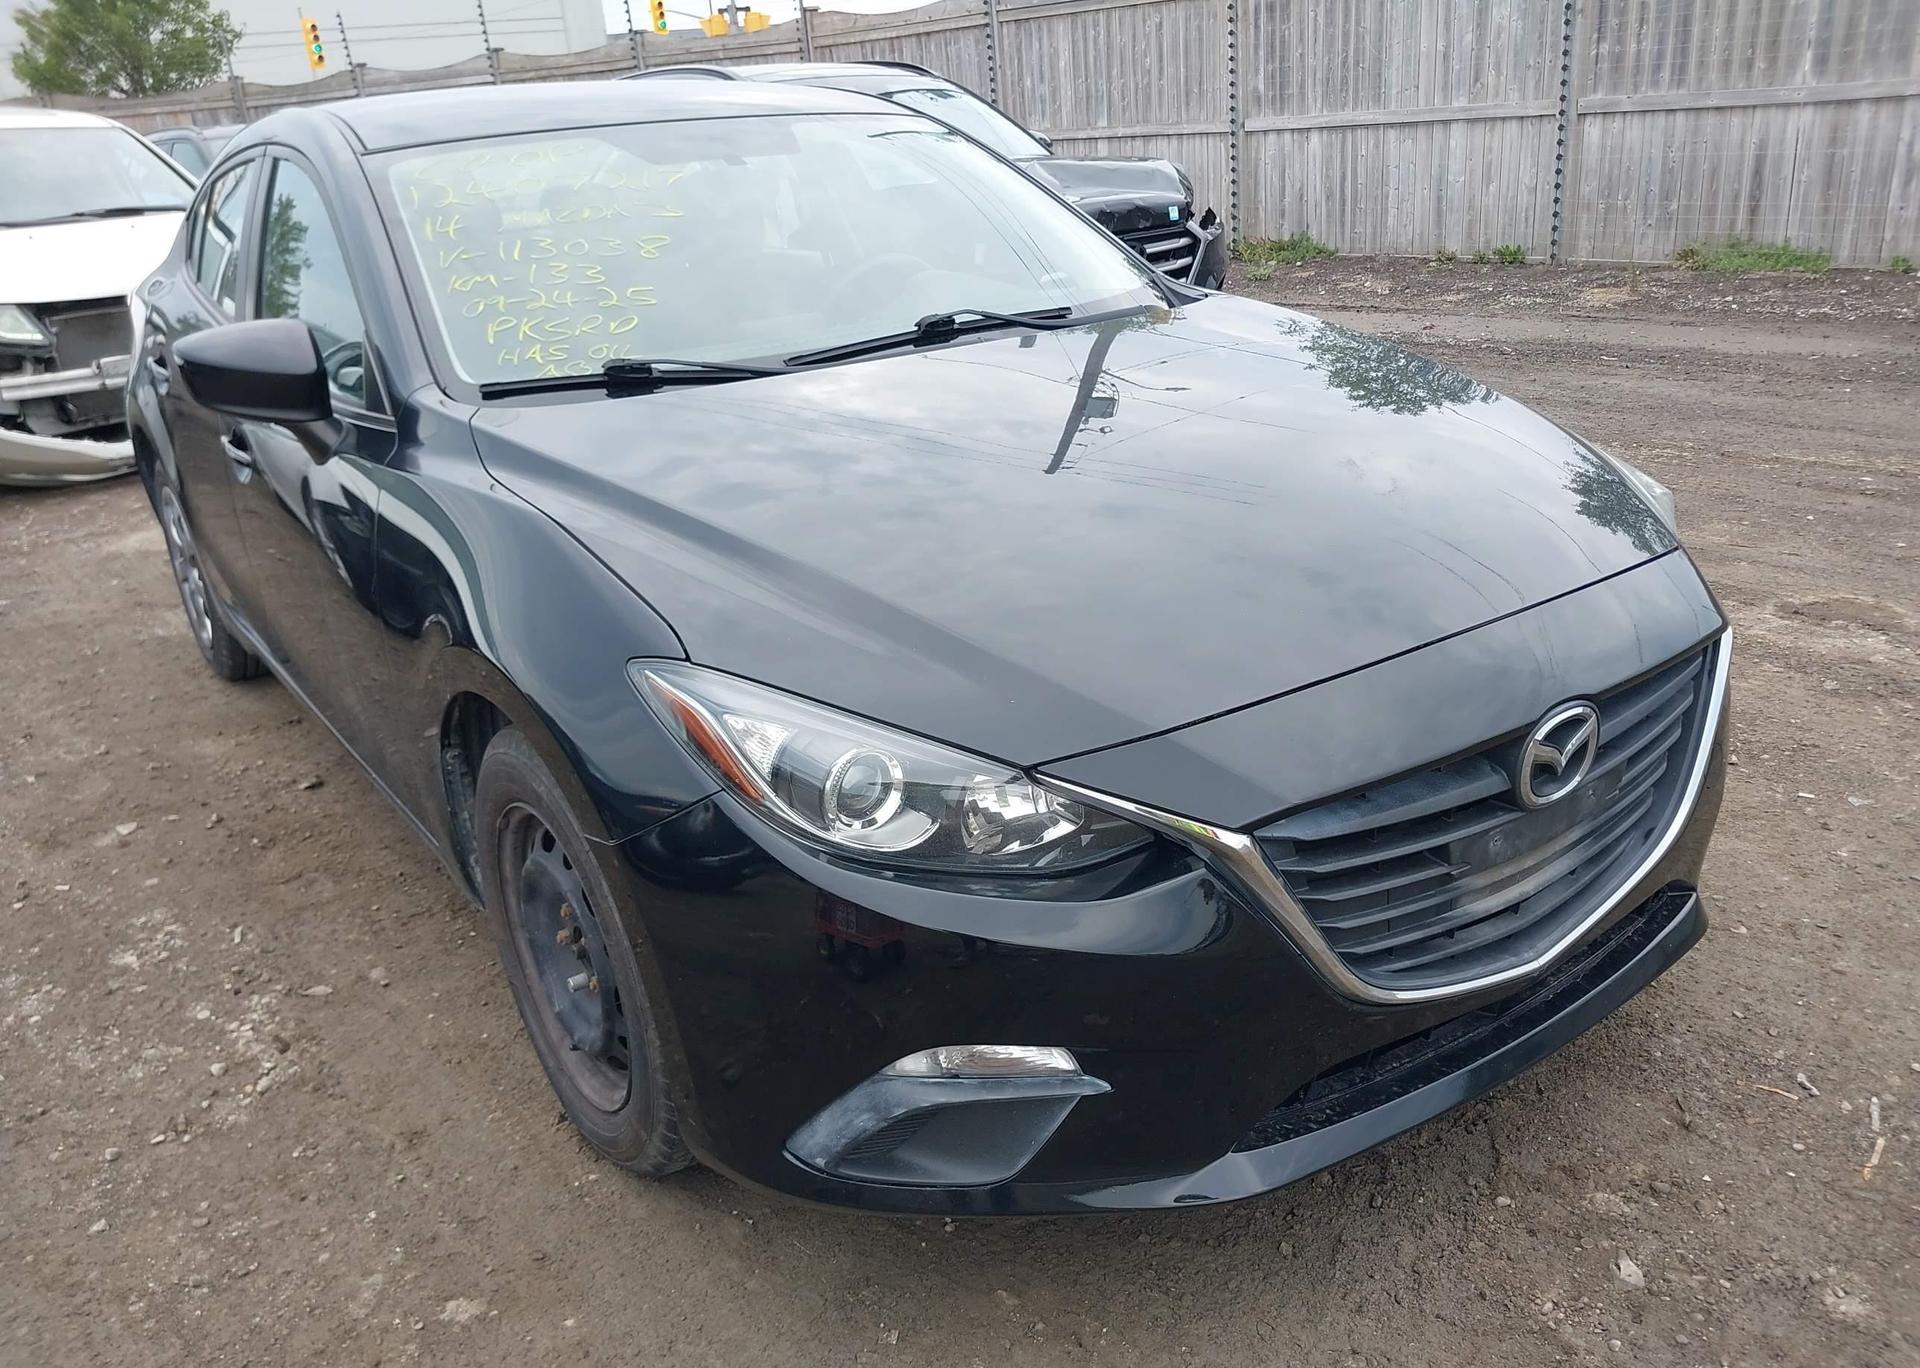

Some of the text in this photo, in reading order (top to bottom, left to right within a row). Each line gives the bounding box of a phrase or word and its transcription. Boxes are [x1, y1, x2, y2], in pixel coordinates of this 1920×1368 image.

[425, 214, 464, 240] 14
[462, 286, 657, 318] 09-24-25
[486, 314, 639, 344] PKSRD
[498, 344, 570, 366] HAS
